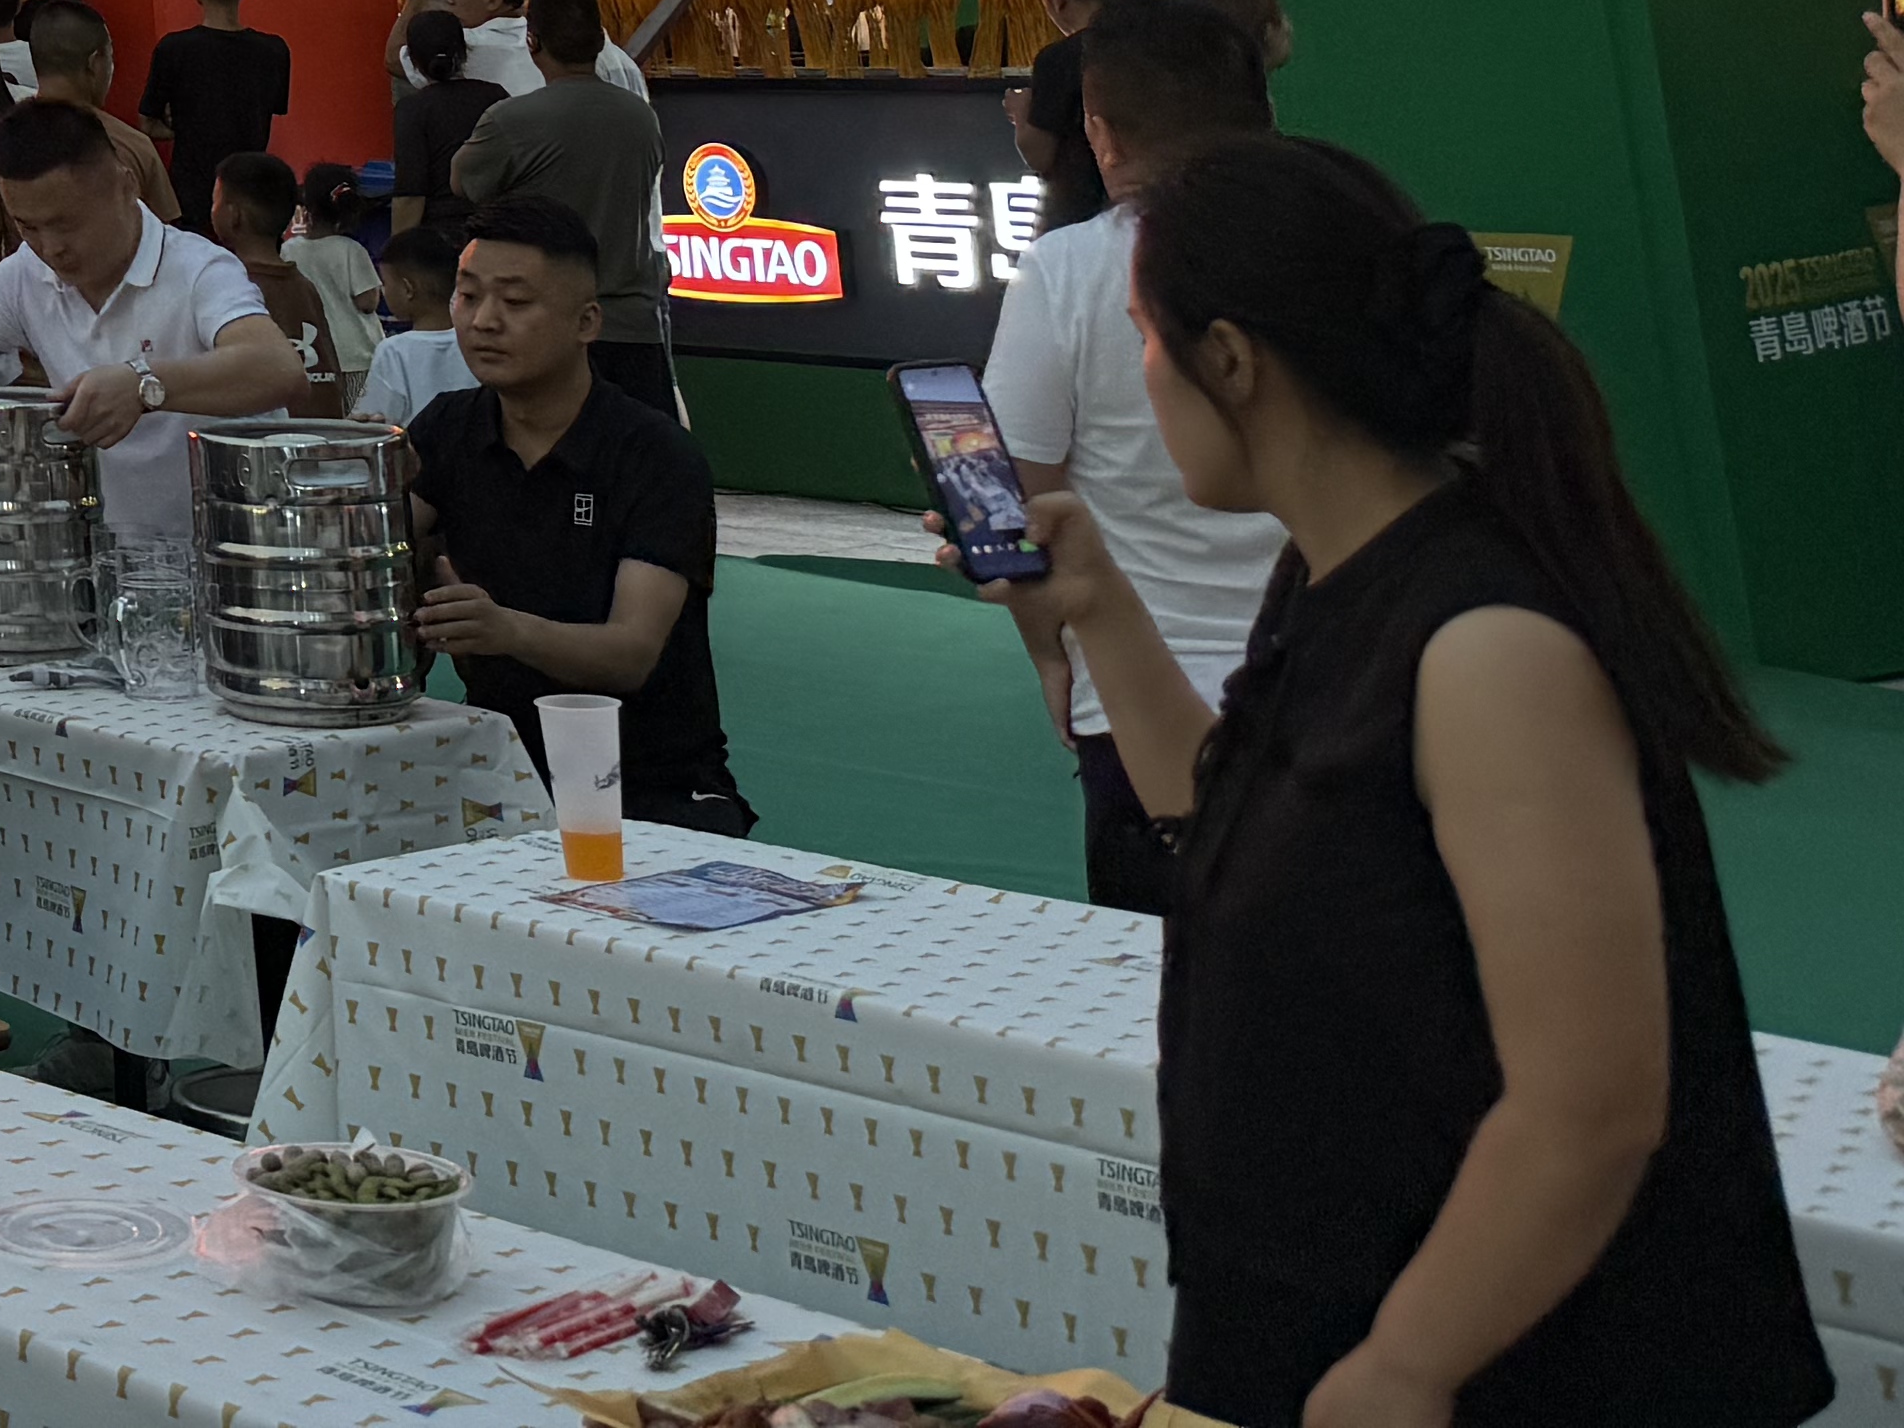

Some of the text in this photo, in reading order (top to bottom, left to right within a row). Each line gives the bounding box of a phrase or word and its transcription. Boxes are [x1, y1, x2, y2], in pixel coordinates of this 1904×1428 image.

[661, 233, 828, 288] SINGTAO
[1486, 246, 1556, 263] TSINGTAO
[1738, 257, 1801, 310] 2025
[1748, 294, 1891, 362] 青島啤酒节
[452, 1008, 515, 1036] TSINGTAO
[1096, 1157, 1161, 1189] TSINGTA
[787, 1218, 857, 1253] TSINGTAO
